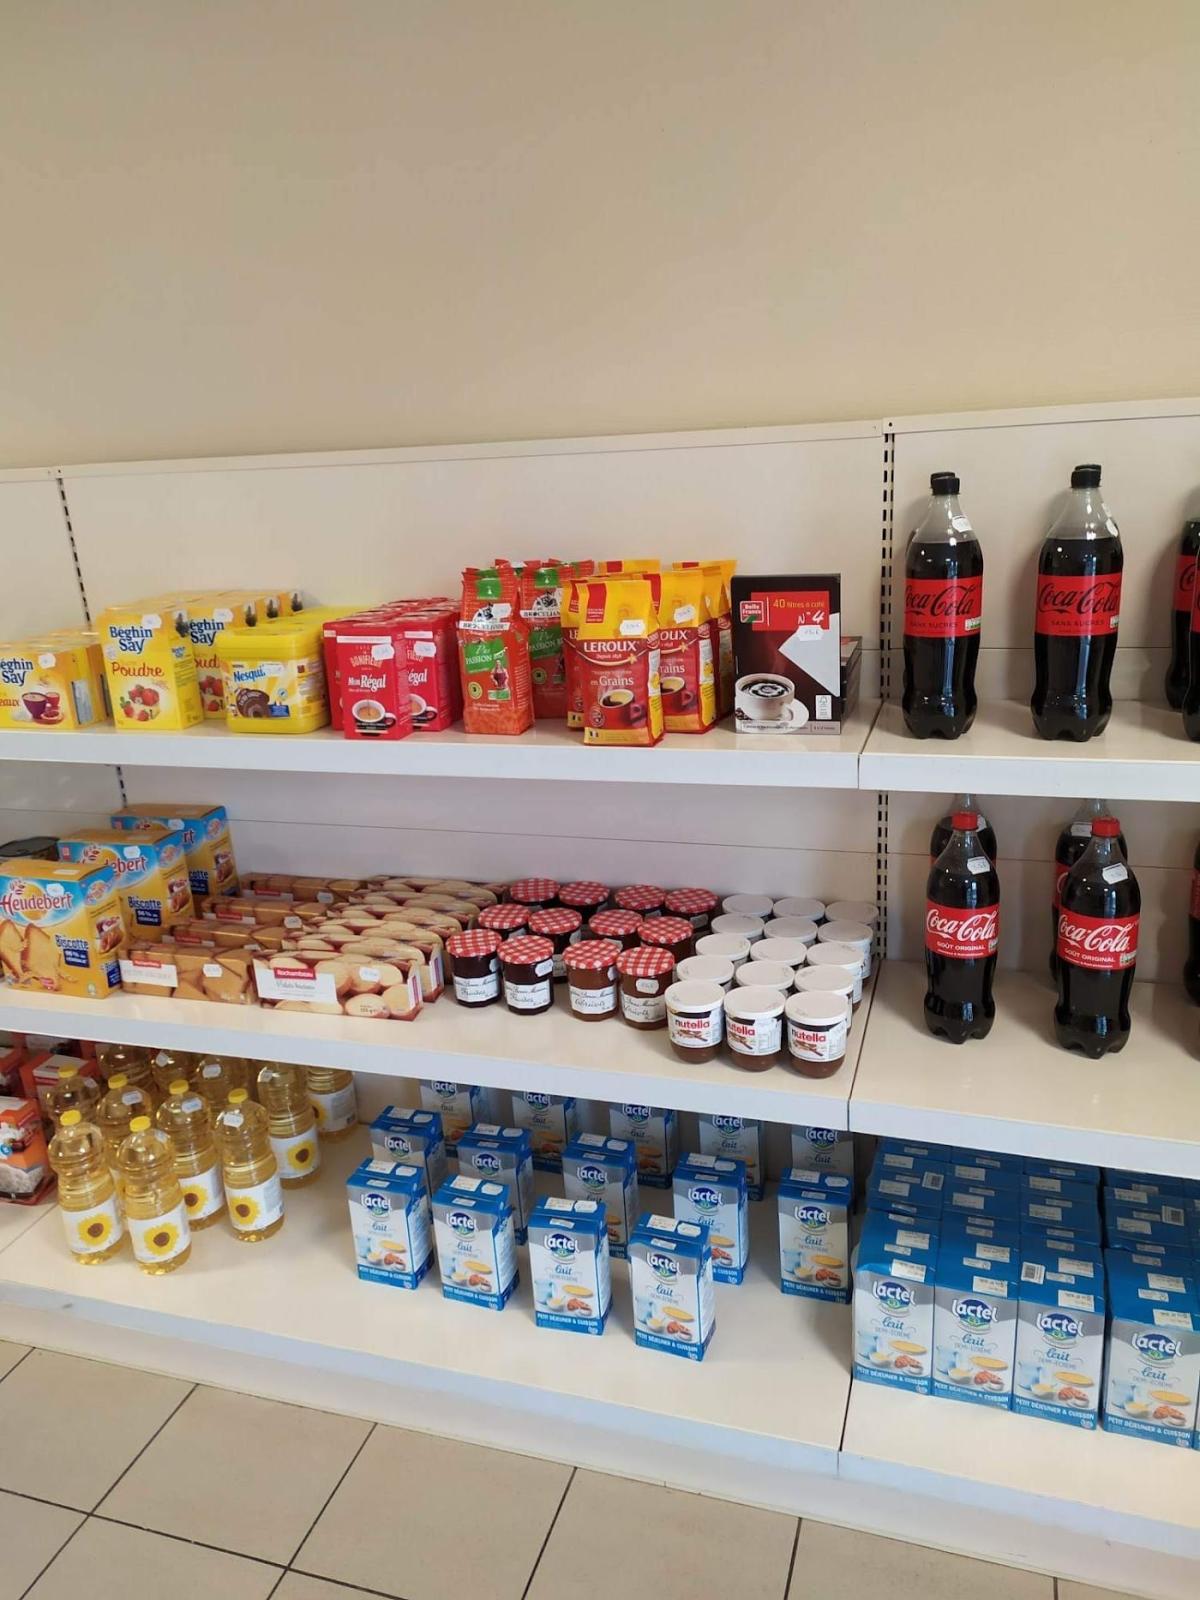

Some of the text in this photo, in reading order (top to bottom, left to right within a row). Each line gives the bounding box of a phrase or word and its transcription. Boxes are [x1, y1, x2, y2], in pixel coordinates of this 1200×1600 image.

[190, 631, 217, 647] Say
[660, 630, 688, 641] OUX
[118, 638, 146, 655] Say
[583, 640, 637, 653] LEROUX
[111, 661, 165, 677] Poudre
[233, 666, 266, 682] Nesqui
[408, 668, 428, 686] égal
[659, 664, 686, 674] rains
[2, 670, 26, 687] Say
[360, 673, 387, 692] Régal
[599, 674, 635, 687] Grains
[0, 894, 73, 916] Heudebert
[927, 909, 997, 942] Coca-Cola
[1059, 914, 1135, 953] Coca-Cola
[674, 1018, 711, 1031] nutella
[791, 1028, 827, 1044] nutella
[576, 1166, 609, 1183] lactel
[361, 1193, 391, 1210] lactel
[687, 1187, 724, 1205] lactel
[446, 1212, 477, 1231] lactel
[794, 1206, 832, 1224] lactel
[544, 1234, 580, 1253] lactel
[646, 1251, 682, 1273] lactel
[872, 1280, 916, 1305] lactel
[952, 1299, 998, 1323] lactel
[1036, 1312, 1084, 1337] lactel
[1131, 1332, 1183, 1358] lactel
